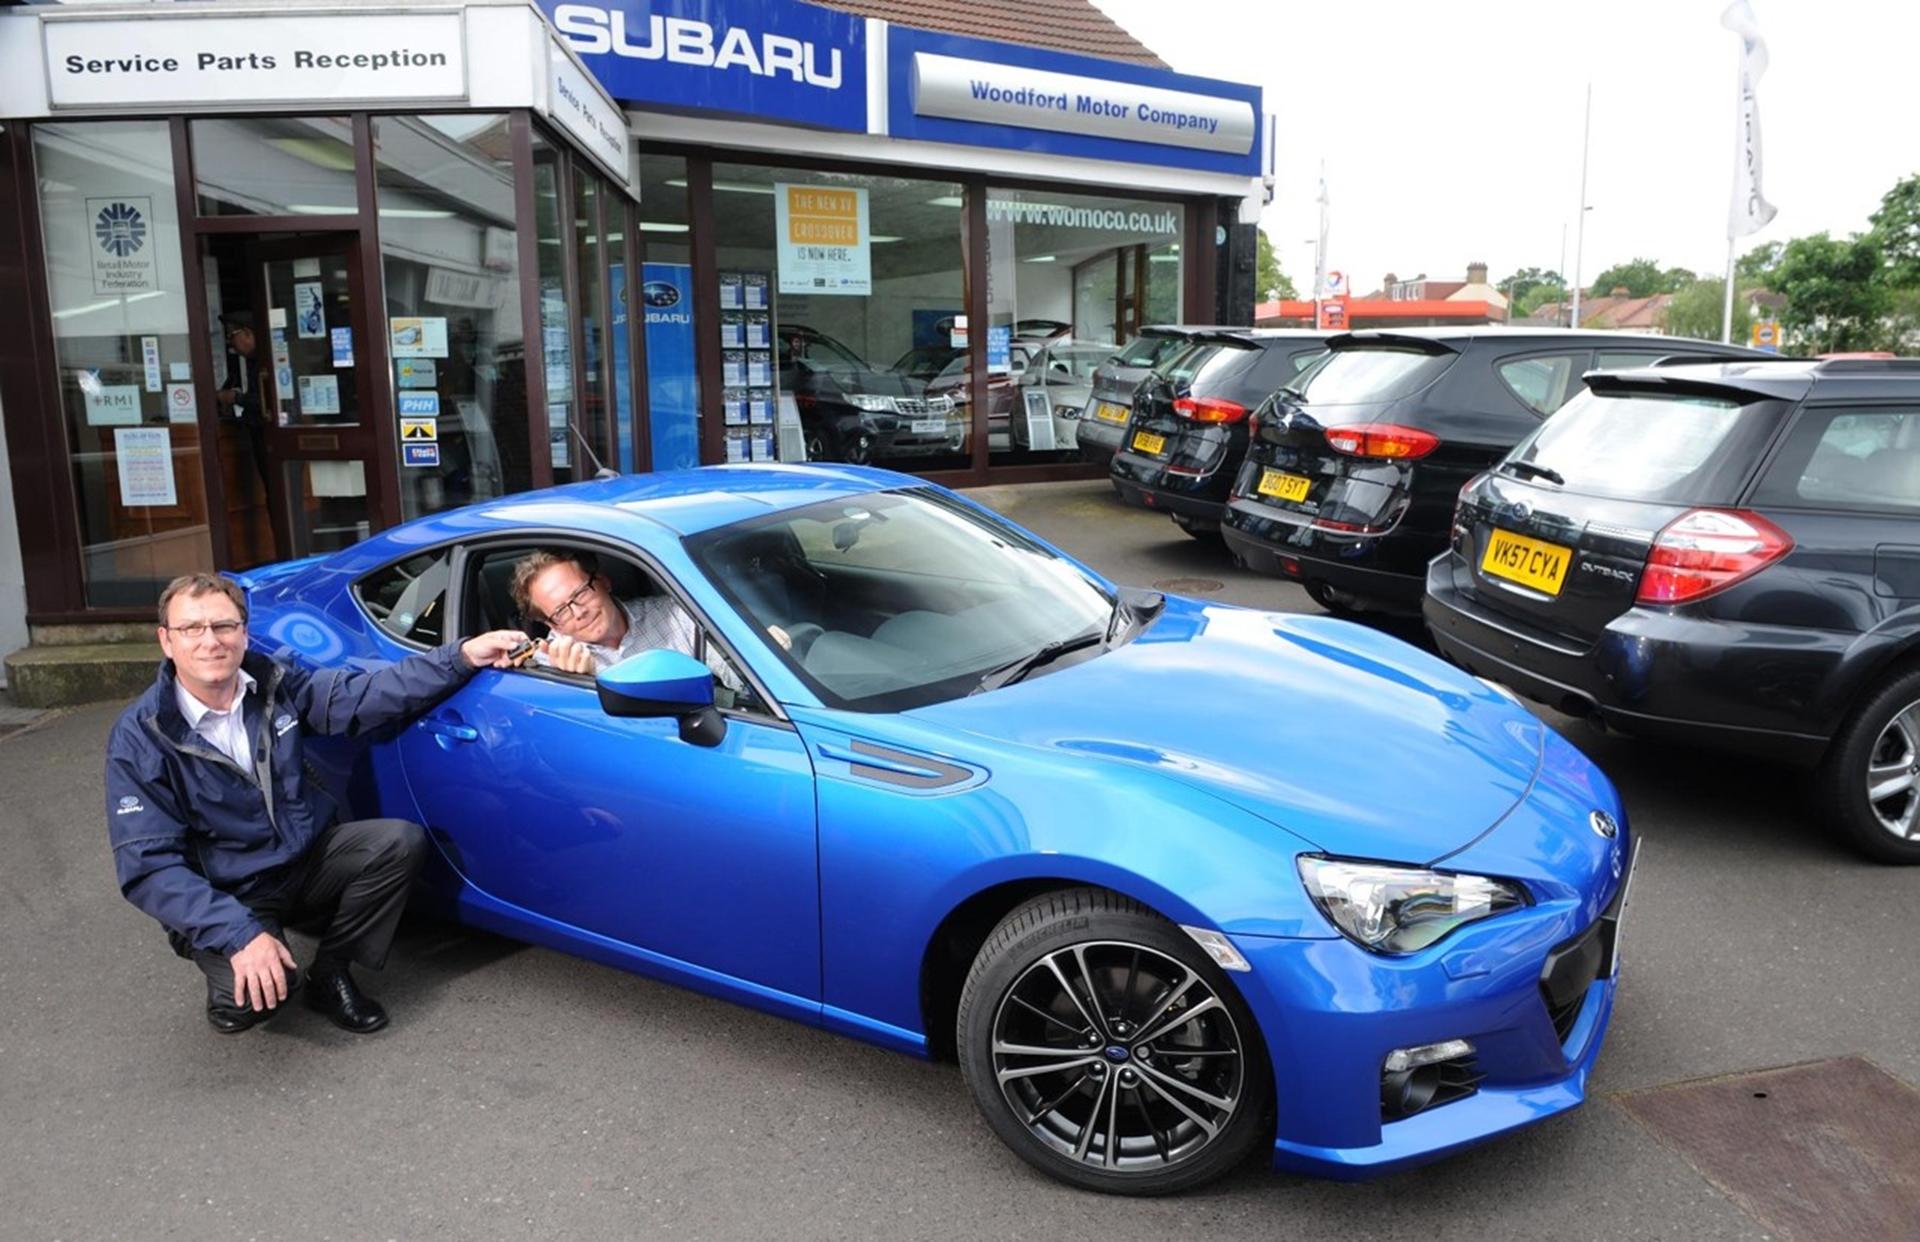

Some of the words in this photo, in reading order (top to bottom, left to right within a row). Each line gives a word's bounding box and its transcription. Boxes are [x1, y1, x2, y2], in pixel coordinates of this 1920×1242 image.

[554, 4, 842, 89] SUBARU
[66, 55, 178, 73] Service
[197, 53, 276, 70] Parts
[294, 49, 446, 70] Reception
[970, 80, 1067, 110] Woodford
[1076, 95, 1129, 118] Motor
[1137, 103, 1218, 134] Company
[794, 193, 814, 209] THE
[986, 201, 1177, 234] www.womoco.co.uk
[797, 247, 806, 260] IS
[808, 247, 825, 260] NOW
[827, 248, 851, 262] HERE.
[403, 399, 434, 411] PHH
[1493, 538, 1531, 569] VK57
[1528, 546, 1561, 581] CYA
[1581, 562, 1634, 582] OUTBACK
